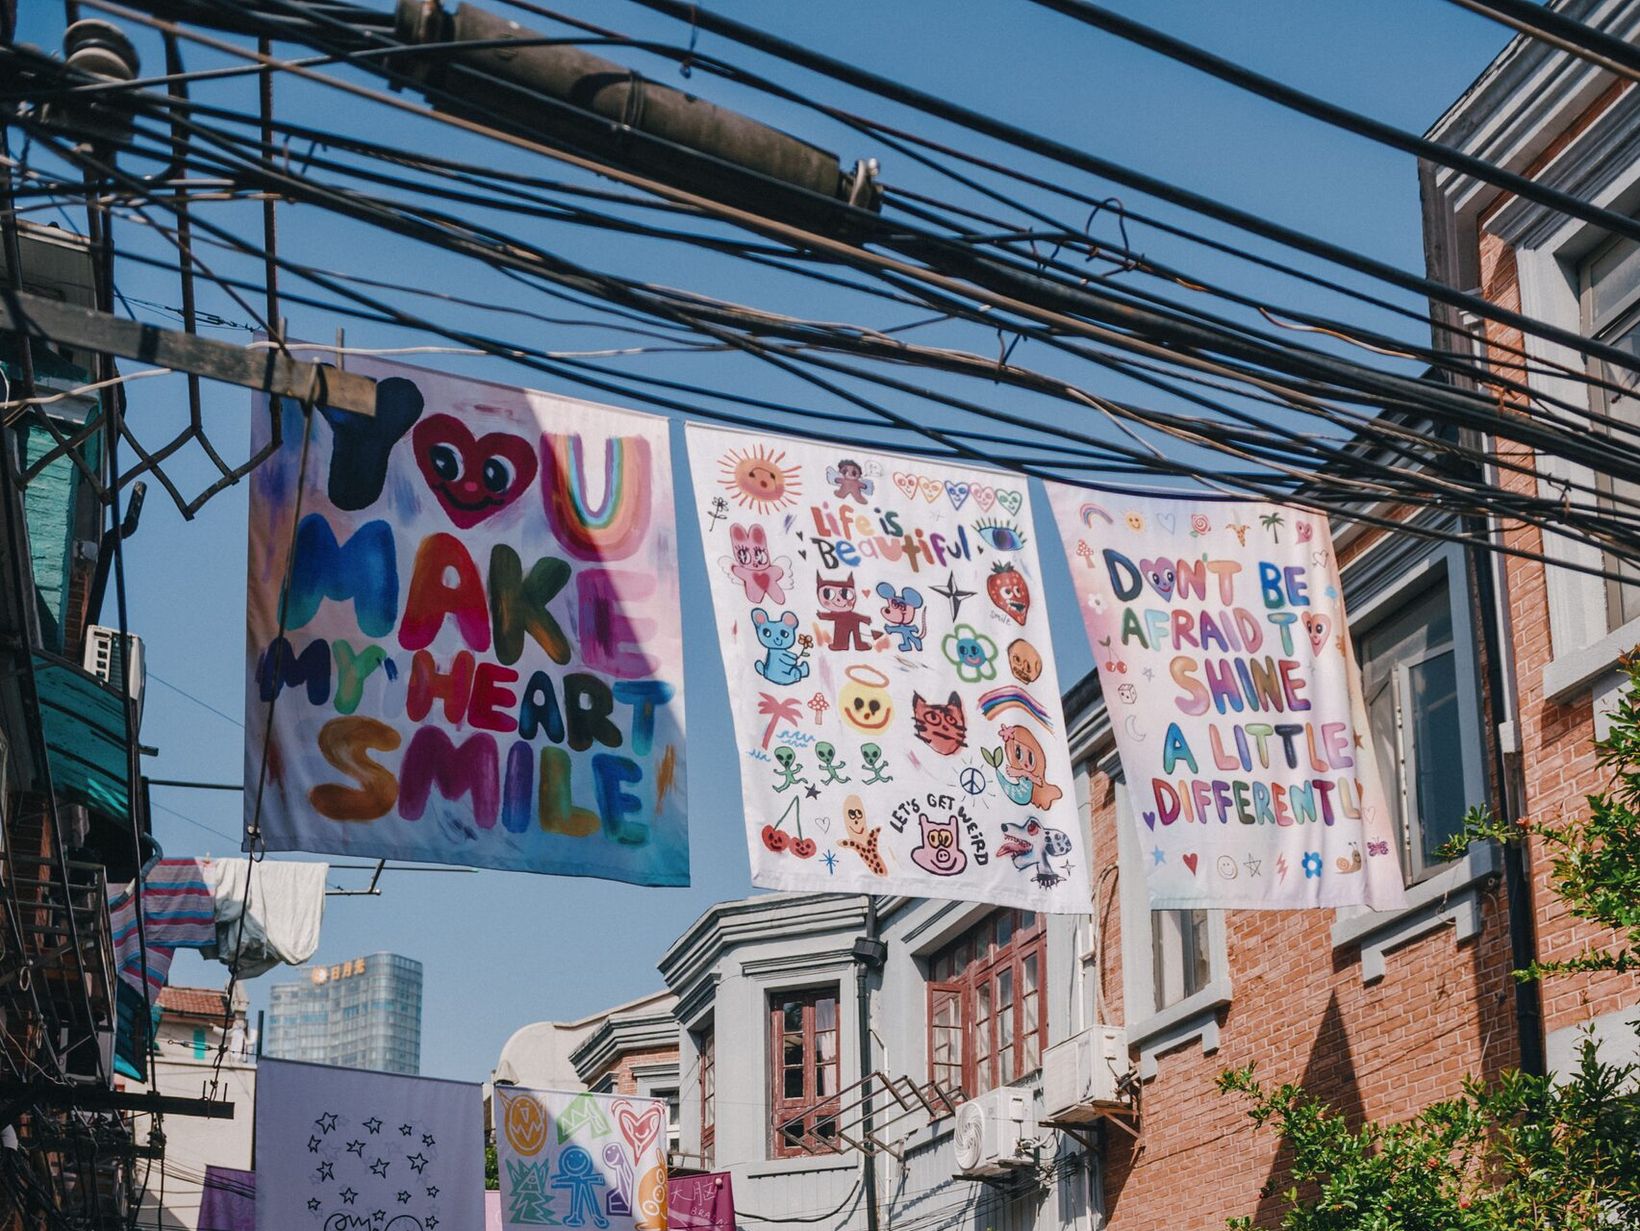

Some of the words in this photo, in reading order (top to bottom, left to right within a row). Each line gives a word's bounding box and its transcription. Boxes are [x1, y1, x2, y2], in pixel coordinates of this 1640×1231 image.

[810, 524, 971, 573] Beautiful
[281, 513, 660, 677] MAKE
[1258, 561, 1311, 608] BE
[1121, 607, 1263, 654] AFRAID
[406, 650, 675, 756] HEART
[1169, 656, 1311, 716] SHINE
[1163, 721, 1199, 774] A
[1208, 722, 1353, 773] LITTLE
[309, 715, 650, 846] SMILE
[890, 798, 921, 834] LET'S
[927, 793, 956, 811] GET
[670, 1181, 717, 1206] 大脑
